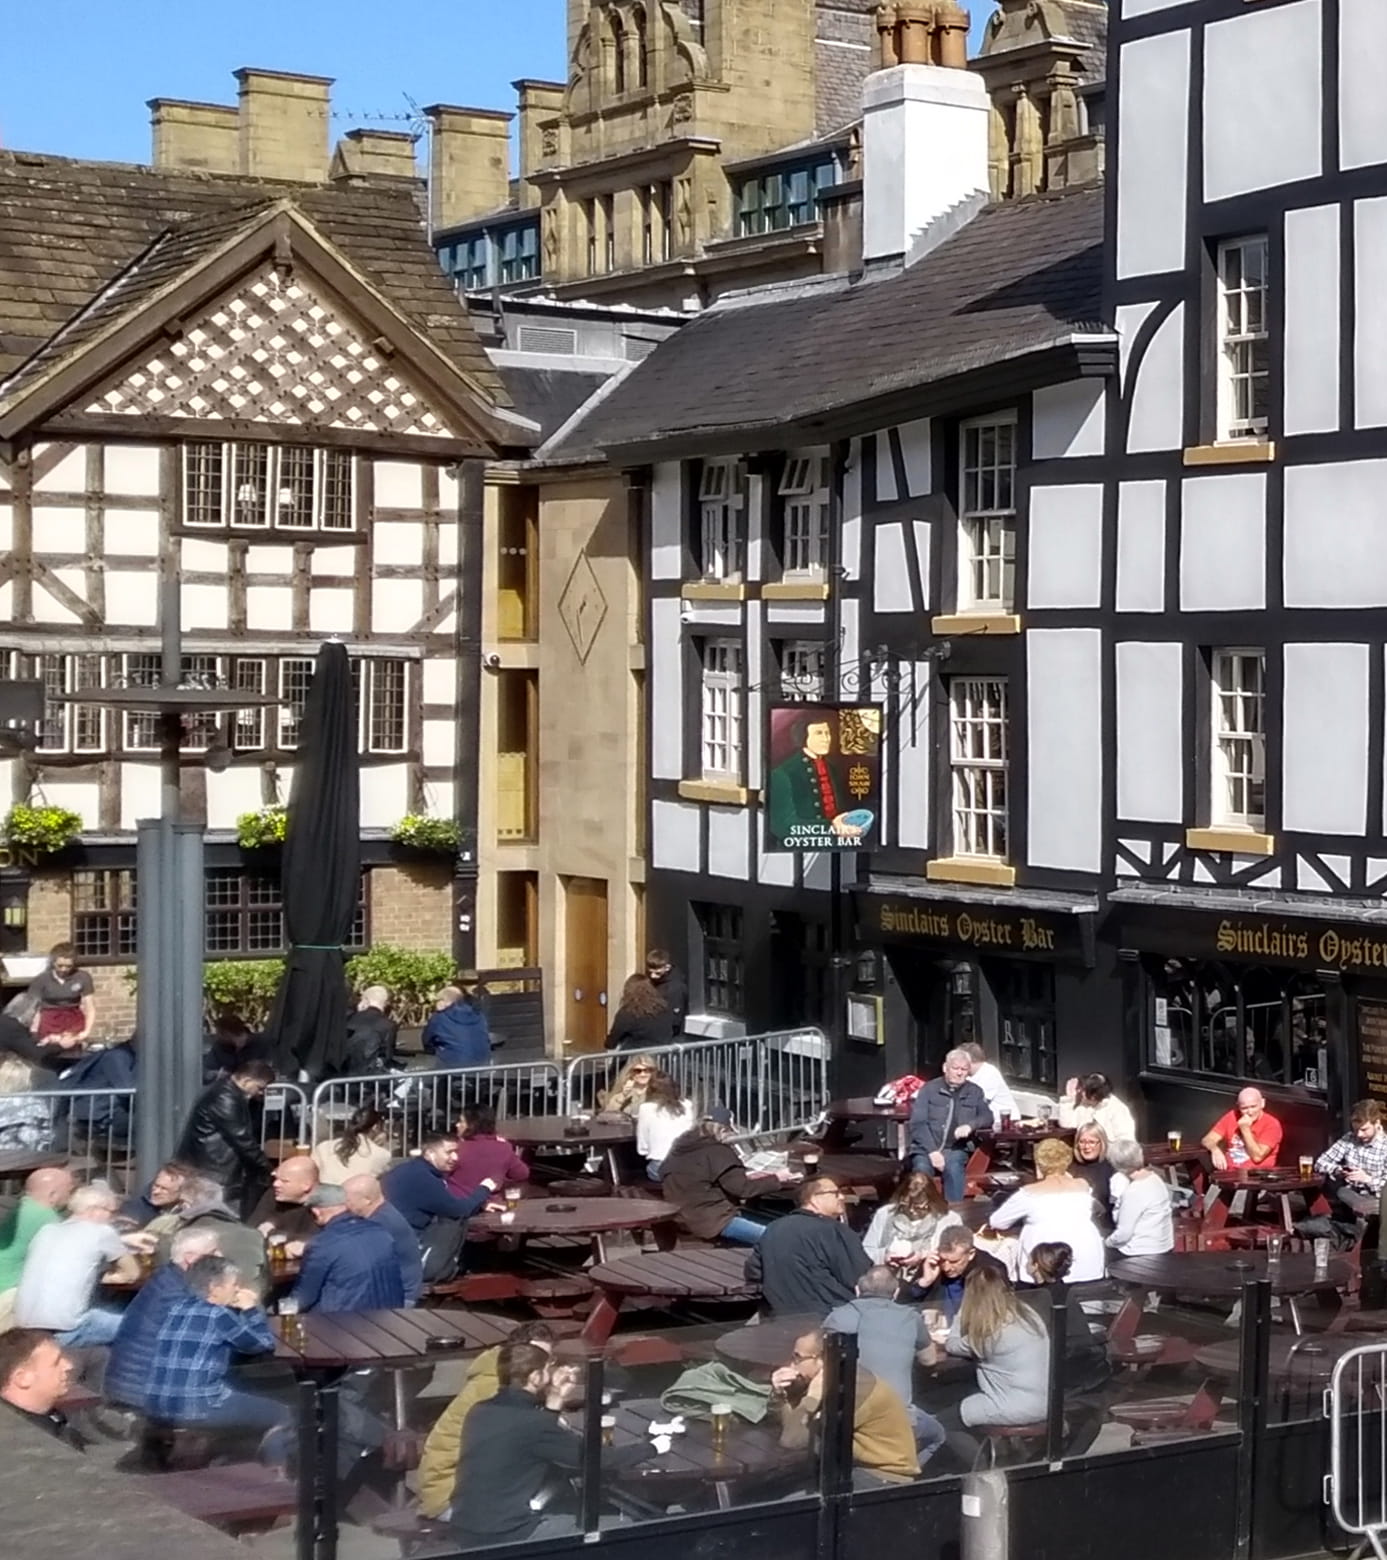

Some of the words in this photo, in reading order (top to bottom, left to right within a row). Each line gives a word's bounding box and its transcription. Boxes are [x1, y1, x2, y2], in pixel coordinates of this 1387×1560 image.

[783, 836, 833, 848] OYSTER
[837, 836, 862, 847] BAR
[880, 904, 950, 937] Sinclairs
[956, 912, 1012, 947] Oyster
[1020, 918, 1055, 951] Bar
[1216, 920, 1309, 958] Sinclairs
